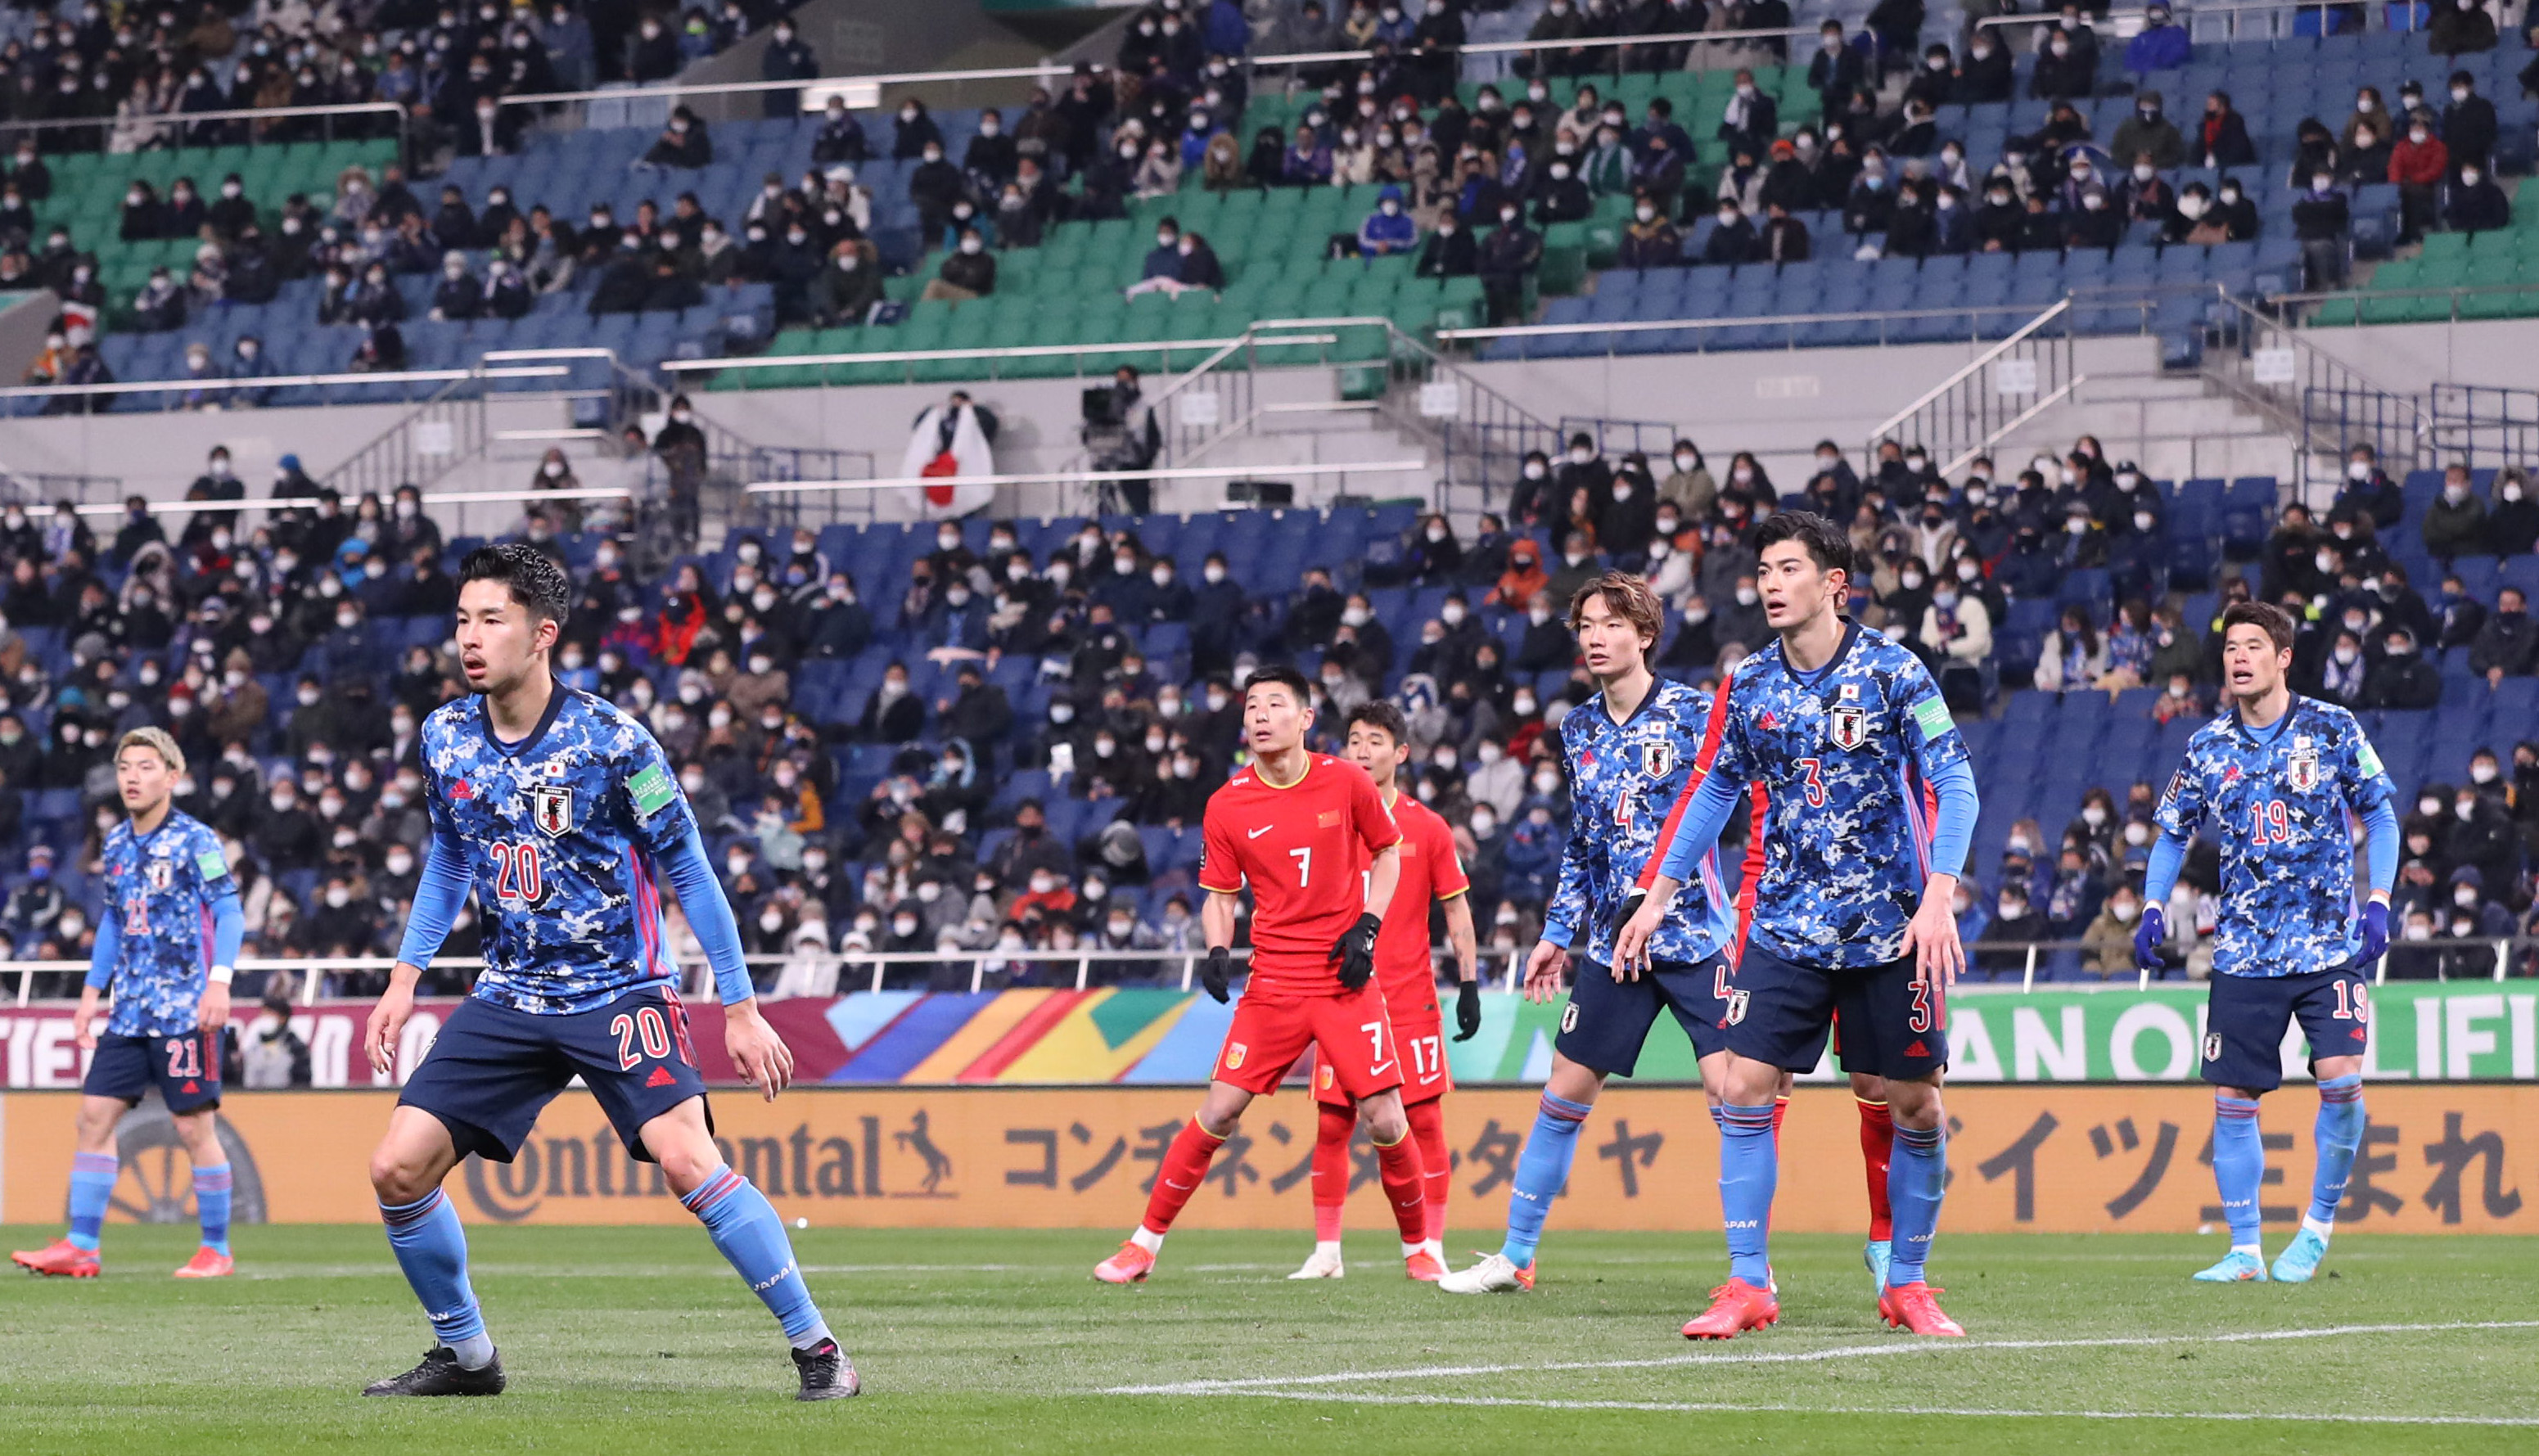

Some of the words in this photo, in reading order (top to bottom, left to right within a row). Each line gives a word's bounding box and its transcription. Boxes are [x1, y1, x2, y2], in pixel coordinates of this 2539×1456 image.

[1801, 758, 1826, 807] 3
[1615, 790, 1632, 833] 4
[2251, 800, 2289, 846] 19
[490, 842, 541, 900] 20
[1289, 847, 1311, 887] 7
[124, 899, 151, 935] 21
[1908, 980, 1931, 1033] 3
[2333, 980, 2368, 1023] 19
[165, 1039, 201, 1077] 21
[610, 1007, 671, 1071] 20
[1361, 1021, 1382, 1062] 7
[1410, 1035, 1440, 1074] 17
